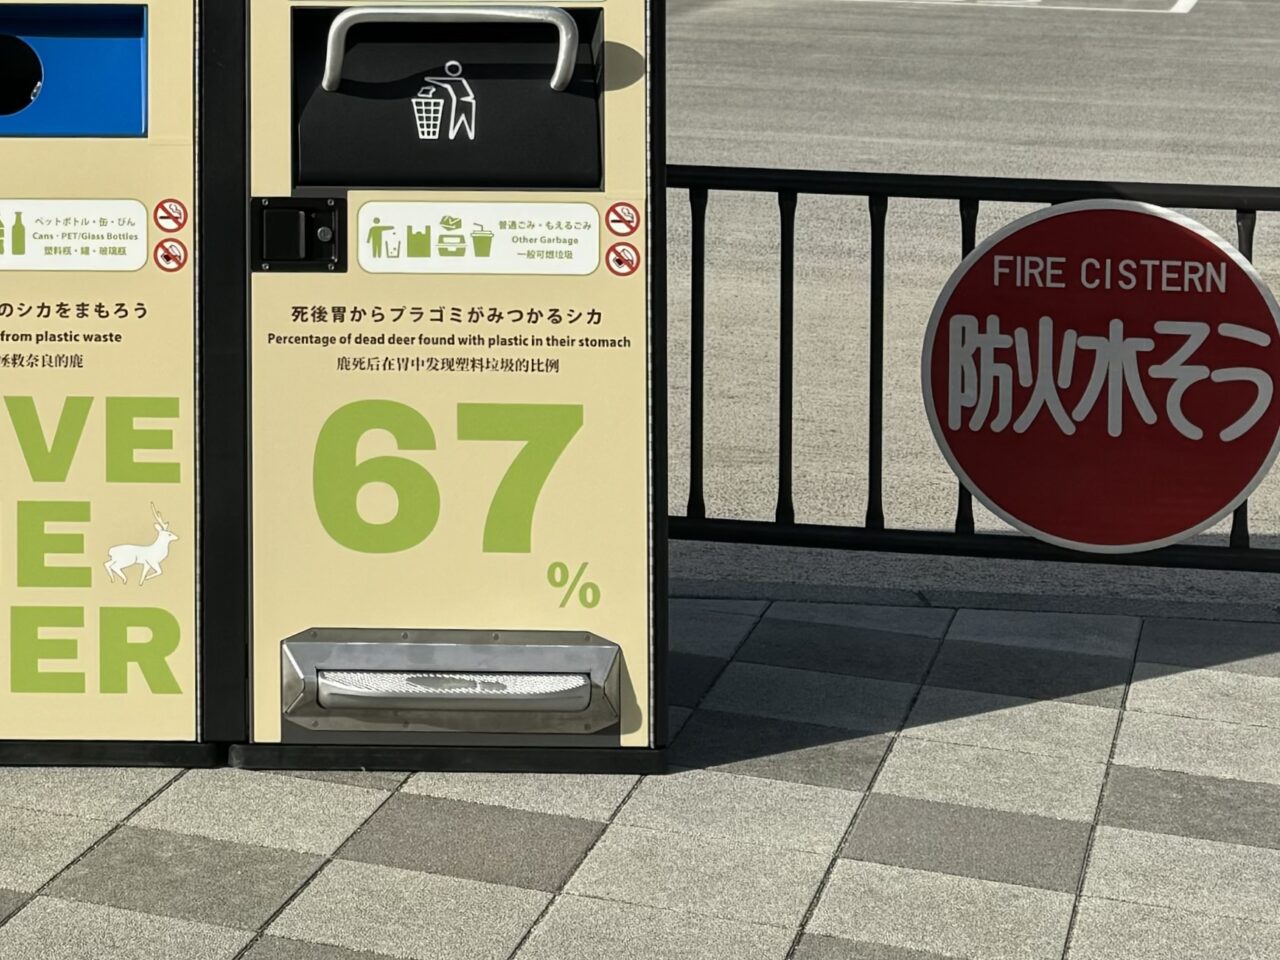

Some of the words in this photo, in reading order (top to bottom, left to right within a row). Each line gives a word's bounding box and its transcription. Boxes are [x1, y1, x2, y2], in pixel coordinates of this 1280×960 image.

[106, 232, 138, 241] Bottles
[511, 235, 538, 244] Other
[539, 235, 579, 246] Garbage
[993, 254, 1067, 289] FIRE
[1080, 257, 1227, 293] CISTERN
[290, 304, 603, 325] 死後胃からプラゴミがみつかるシカ
[0, 330, 33, 342] from
[35, 330, 80, 345] plastic
[82, 332, 123, 343] waste
[267, 332, 337, 348] Percentage
[338, 333, 353, 346] of
[354, 333, 386, 346] dead
[387, 333, 416, 346] deer
[417, 333, 456, 346] found
[457, 333, 485, 346] with
[487, 334, 529, 348] plastic
[531, 335, 544, 347] in
[545, 335, 577, 347] their
[578, 335, 631, 348] stomach
[335, 355, 560, 374] 鹿死后在胃中发现塑料垃圾的比例
[948, 314, 1274, 442] 防火水そう
[312, 399, 584, 554] 67
[547, 561, 601, 609] %
